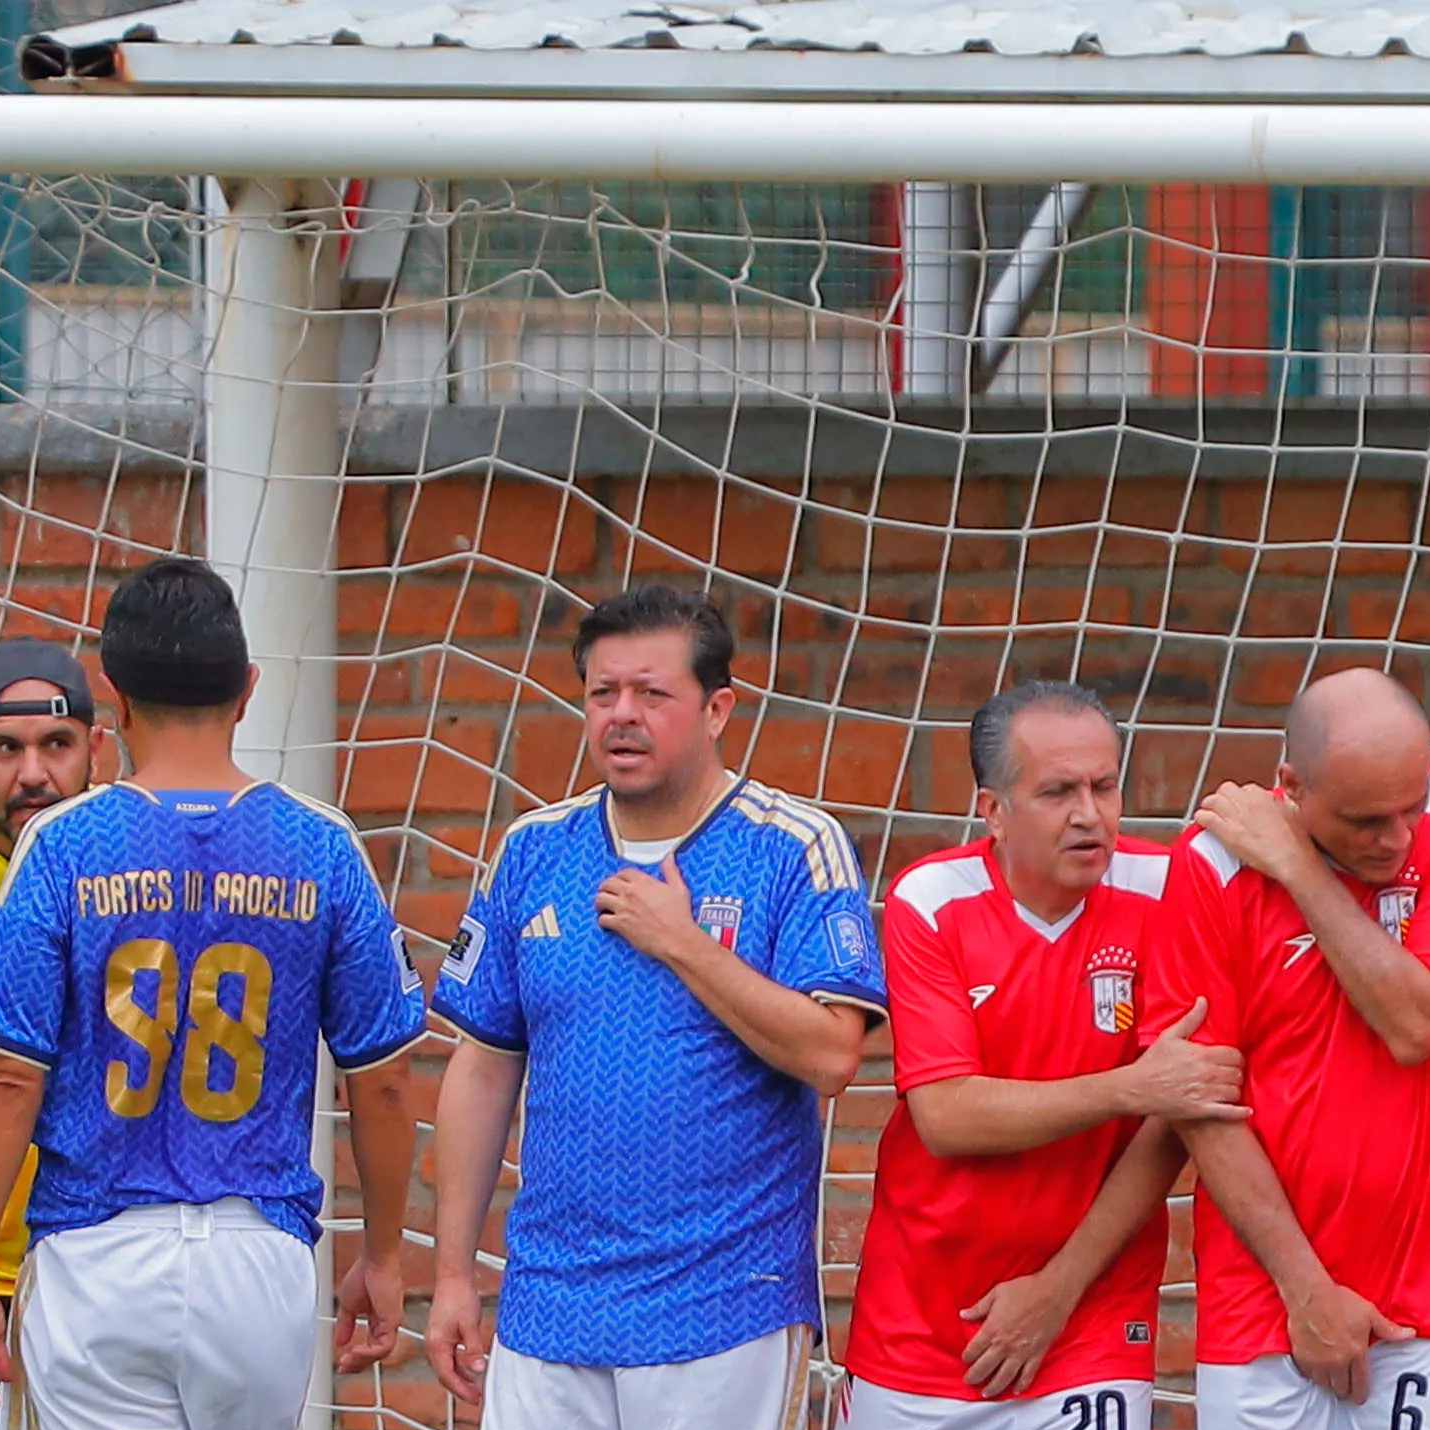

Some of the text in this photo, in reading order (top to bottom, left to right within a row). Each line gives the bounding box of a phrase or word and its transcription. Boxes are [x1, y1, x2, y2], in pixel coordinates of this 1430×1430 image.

[77, 869, 174, 918] FORTES
[214, 872, 318, 922] PROELIO
[104, 937, 274, 1123] 98
